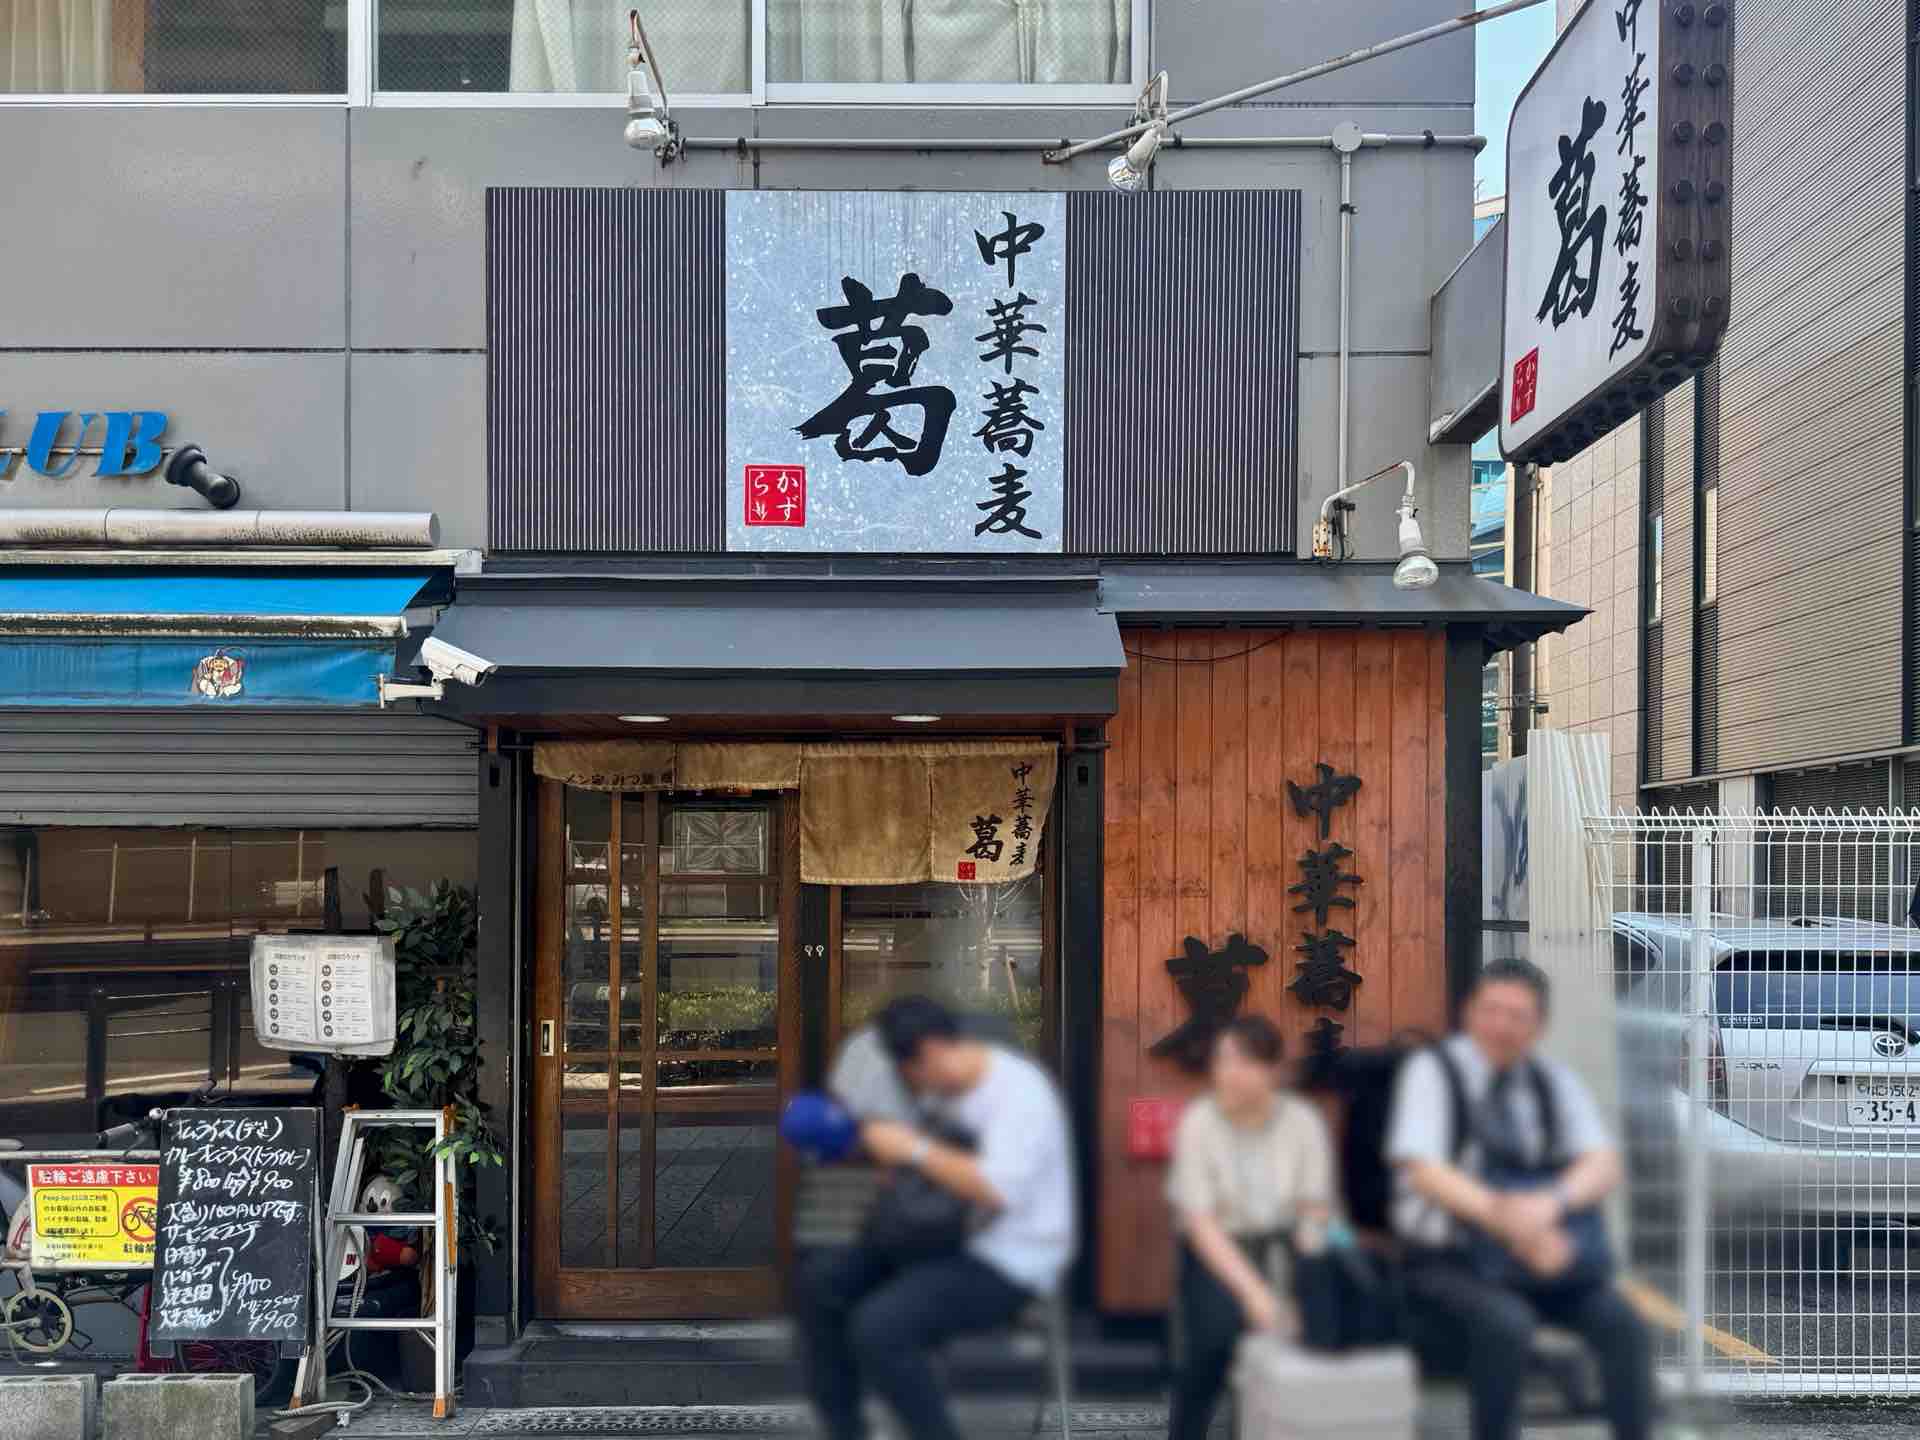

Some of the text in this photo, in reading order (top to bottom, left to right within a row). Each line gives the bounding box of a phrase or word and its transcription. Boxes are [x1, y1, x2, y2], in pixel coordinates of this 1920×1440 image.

[1535, 95, 1606, 330] 葛
[0, 411, 168, 476] UB
[790, 272, 957, 477] 葛
[973, 211, 1047, 539] 中華蕎麦
[965, 814, 1003, 862] 葛
[1009, 761, 1035, 866] 中華蕎麦
